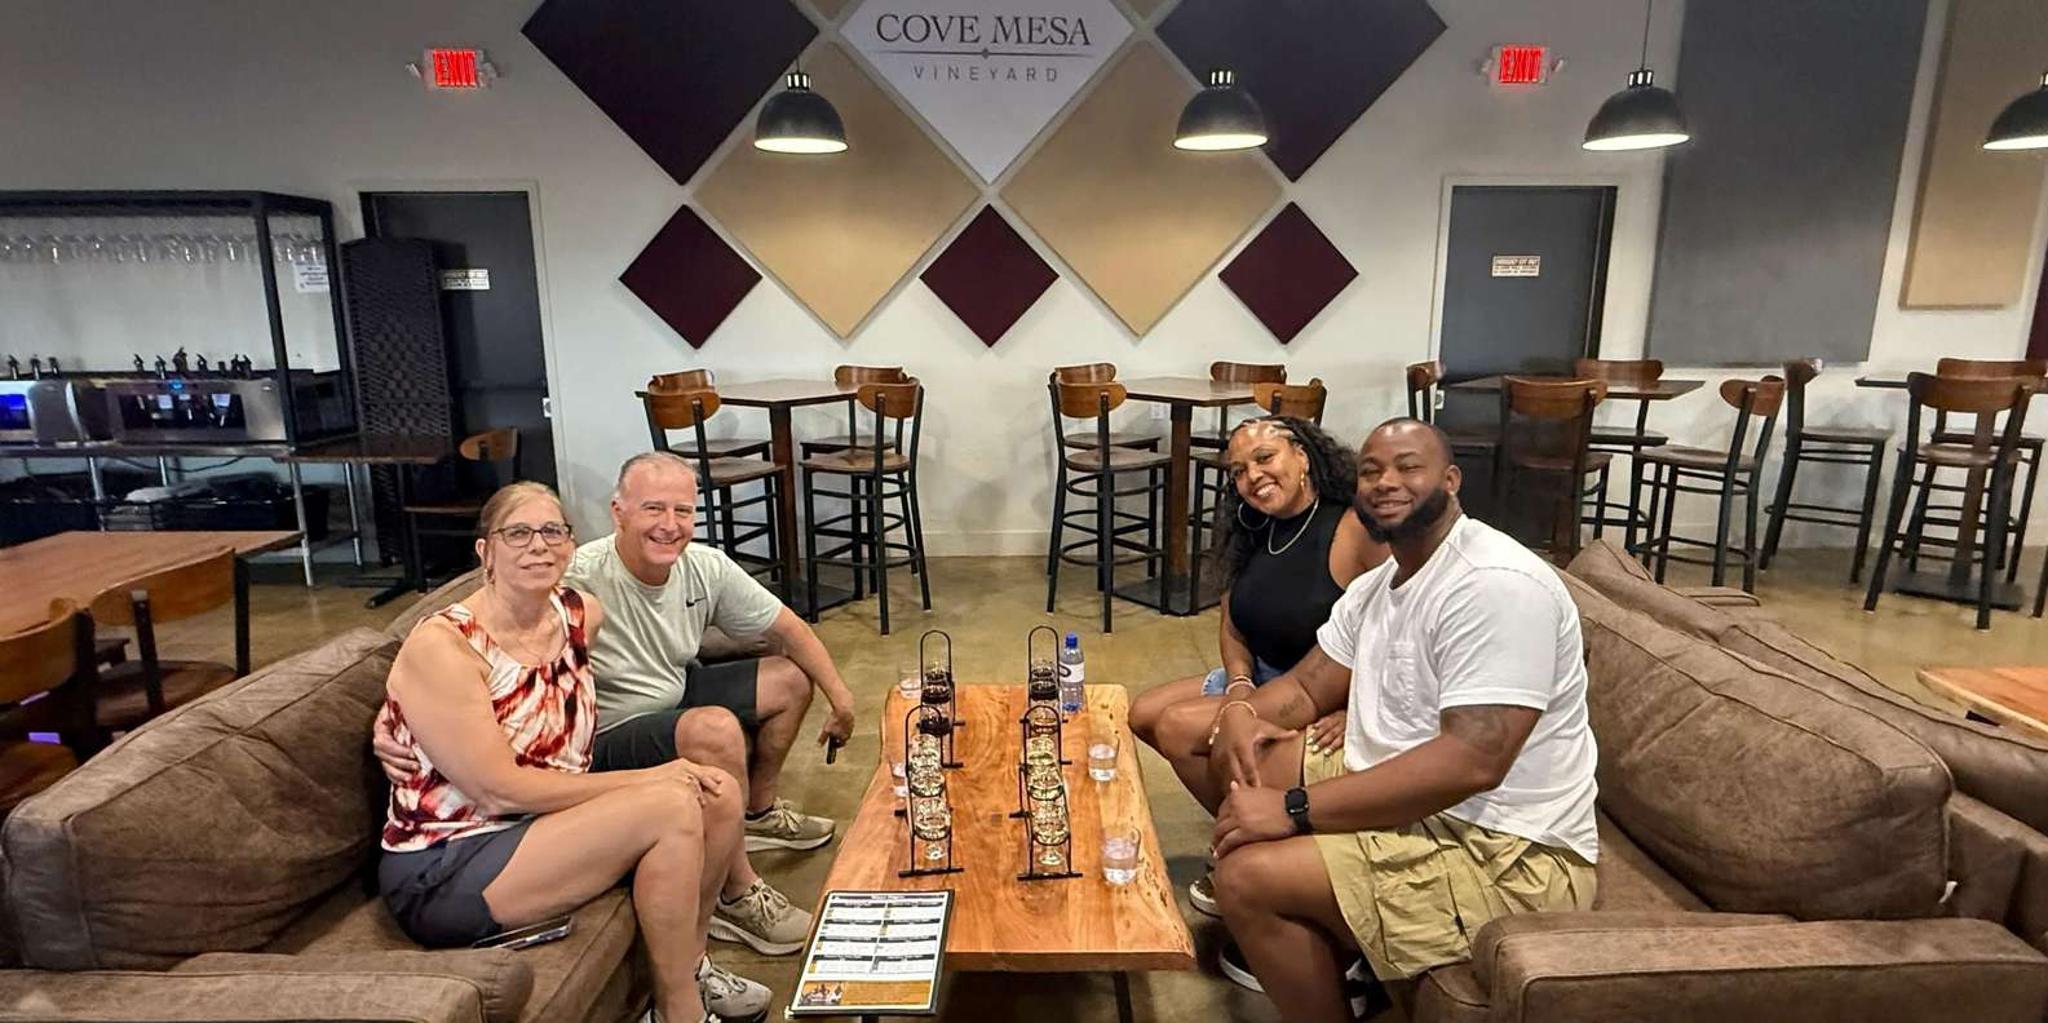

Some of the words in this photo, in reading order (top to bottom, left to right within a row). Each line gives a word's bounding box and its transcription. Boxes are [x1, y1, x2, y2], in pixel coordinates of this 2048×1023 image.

[876, 14, 981, 42] COVE
[990, 16, 1091, 46] MESA
[433, 49, 477, 87] EXIT
[913, 65, 1059, 82] VINEYARD
[1500, 47, 1544, 83] EXIT
